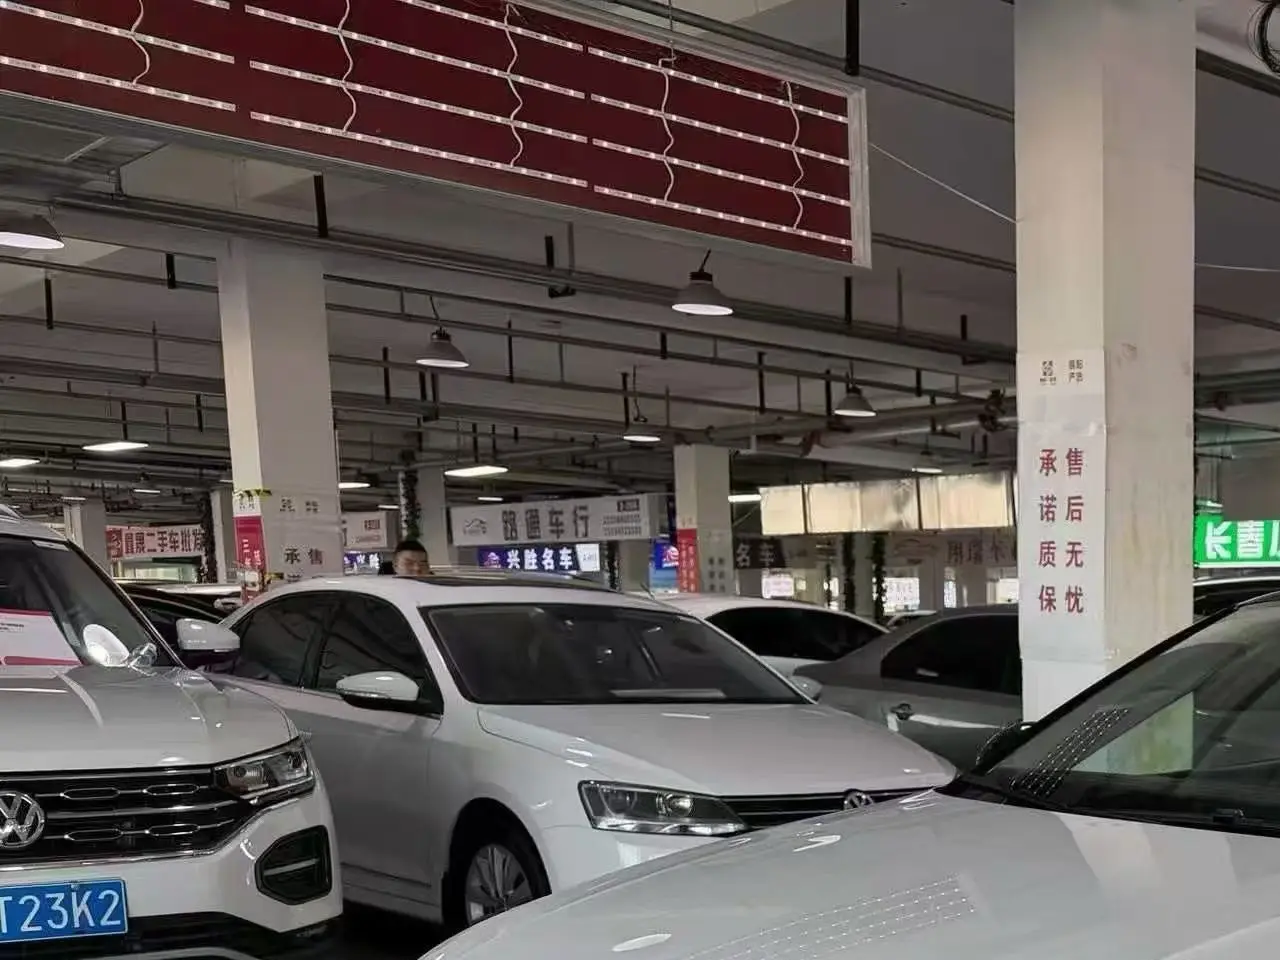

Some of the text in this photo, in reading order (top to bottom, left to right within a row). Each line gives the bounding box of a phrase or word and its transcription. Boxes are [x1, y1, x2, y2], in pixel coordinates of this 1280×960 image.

[1039, 449, 1057, 613] 承诺质保
[1065, 447, 1084, 613] 售后无忧
